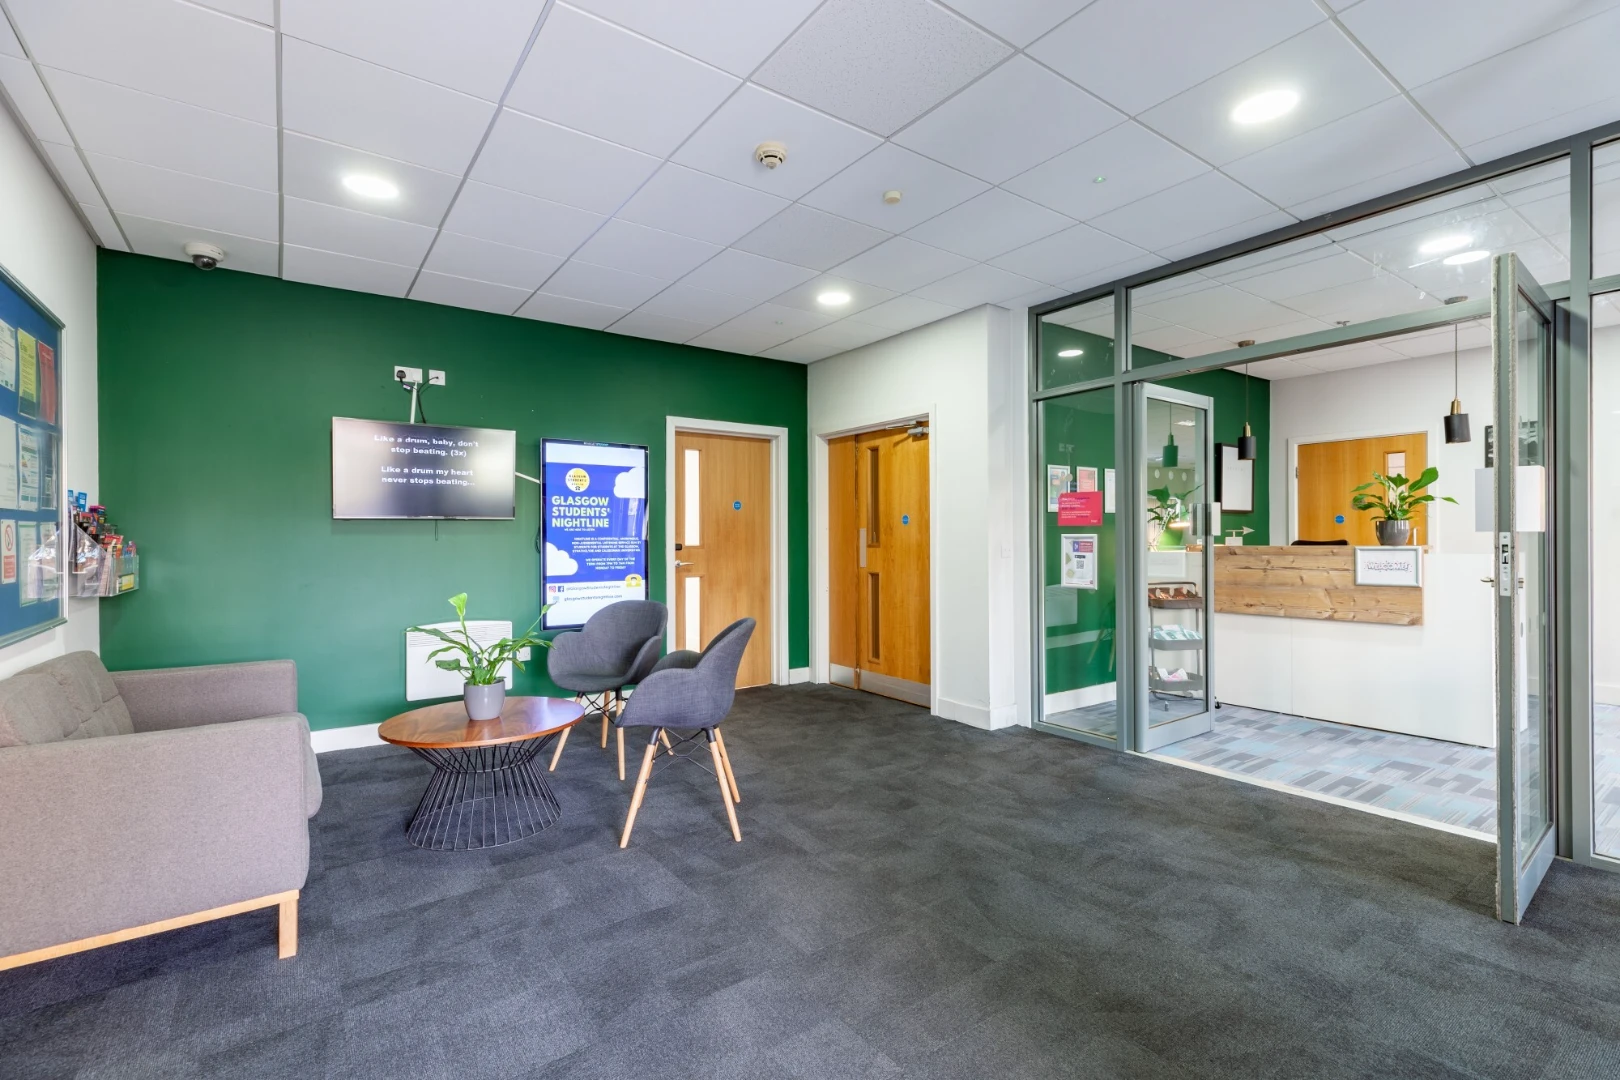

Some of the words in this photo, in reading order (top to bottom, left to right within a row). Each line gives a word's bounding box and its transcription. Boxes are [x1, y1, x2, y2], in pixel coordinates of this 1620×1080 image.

[374, 434, 395, 443] Like
[405, 437, 430, 446] drum,
[432, 438, 456, 447] baby,
[391, 446, 410, 455] stop
[413, 447, 448, 457] beating.
[450, 449, 467, 457] (3x)
[381, 465, 401, 473] Like
[450, 468, 473, 476] heart
[409, 477, 434, 485] stops
[436, 478, 476, 487] beating...
[551, 495, 609, 506] GLASGOW
[551, 506, 611, 517] STUDENTS'
[551, 517, 610, 528] NIGHTLINE
